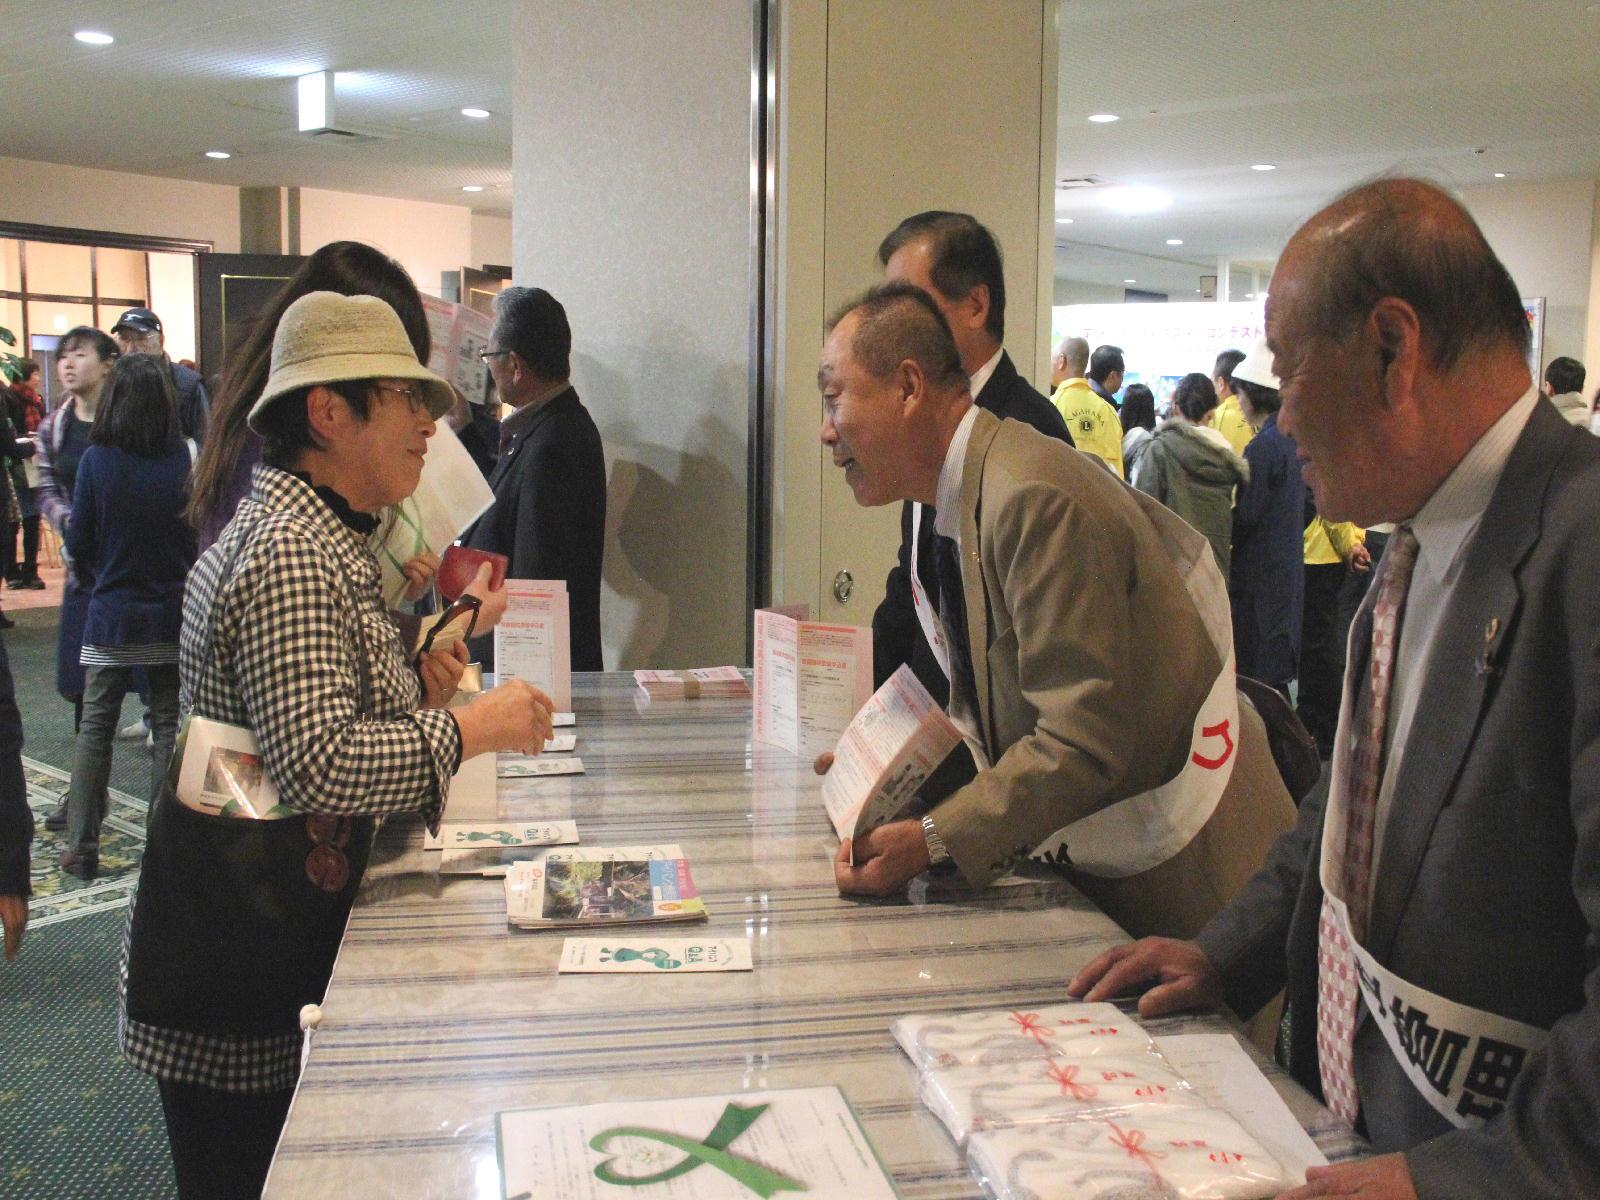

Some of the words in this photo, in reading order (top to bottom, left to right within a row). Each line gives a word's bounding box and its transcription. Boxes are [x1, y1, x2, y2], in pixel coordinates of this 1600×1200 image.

[1207, 326, 1263, 338] コンテスト
